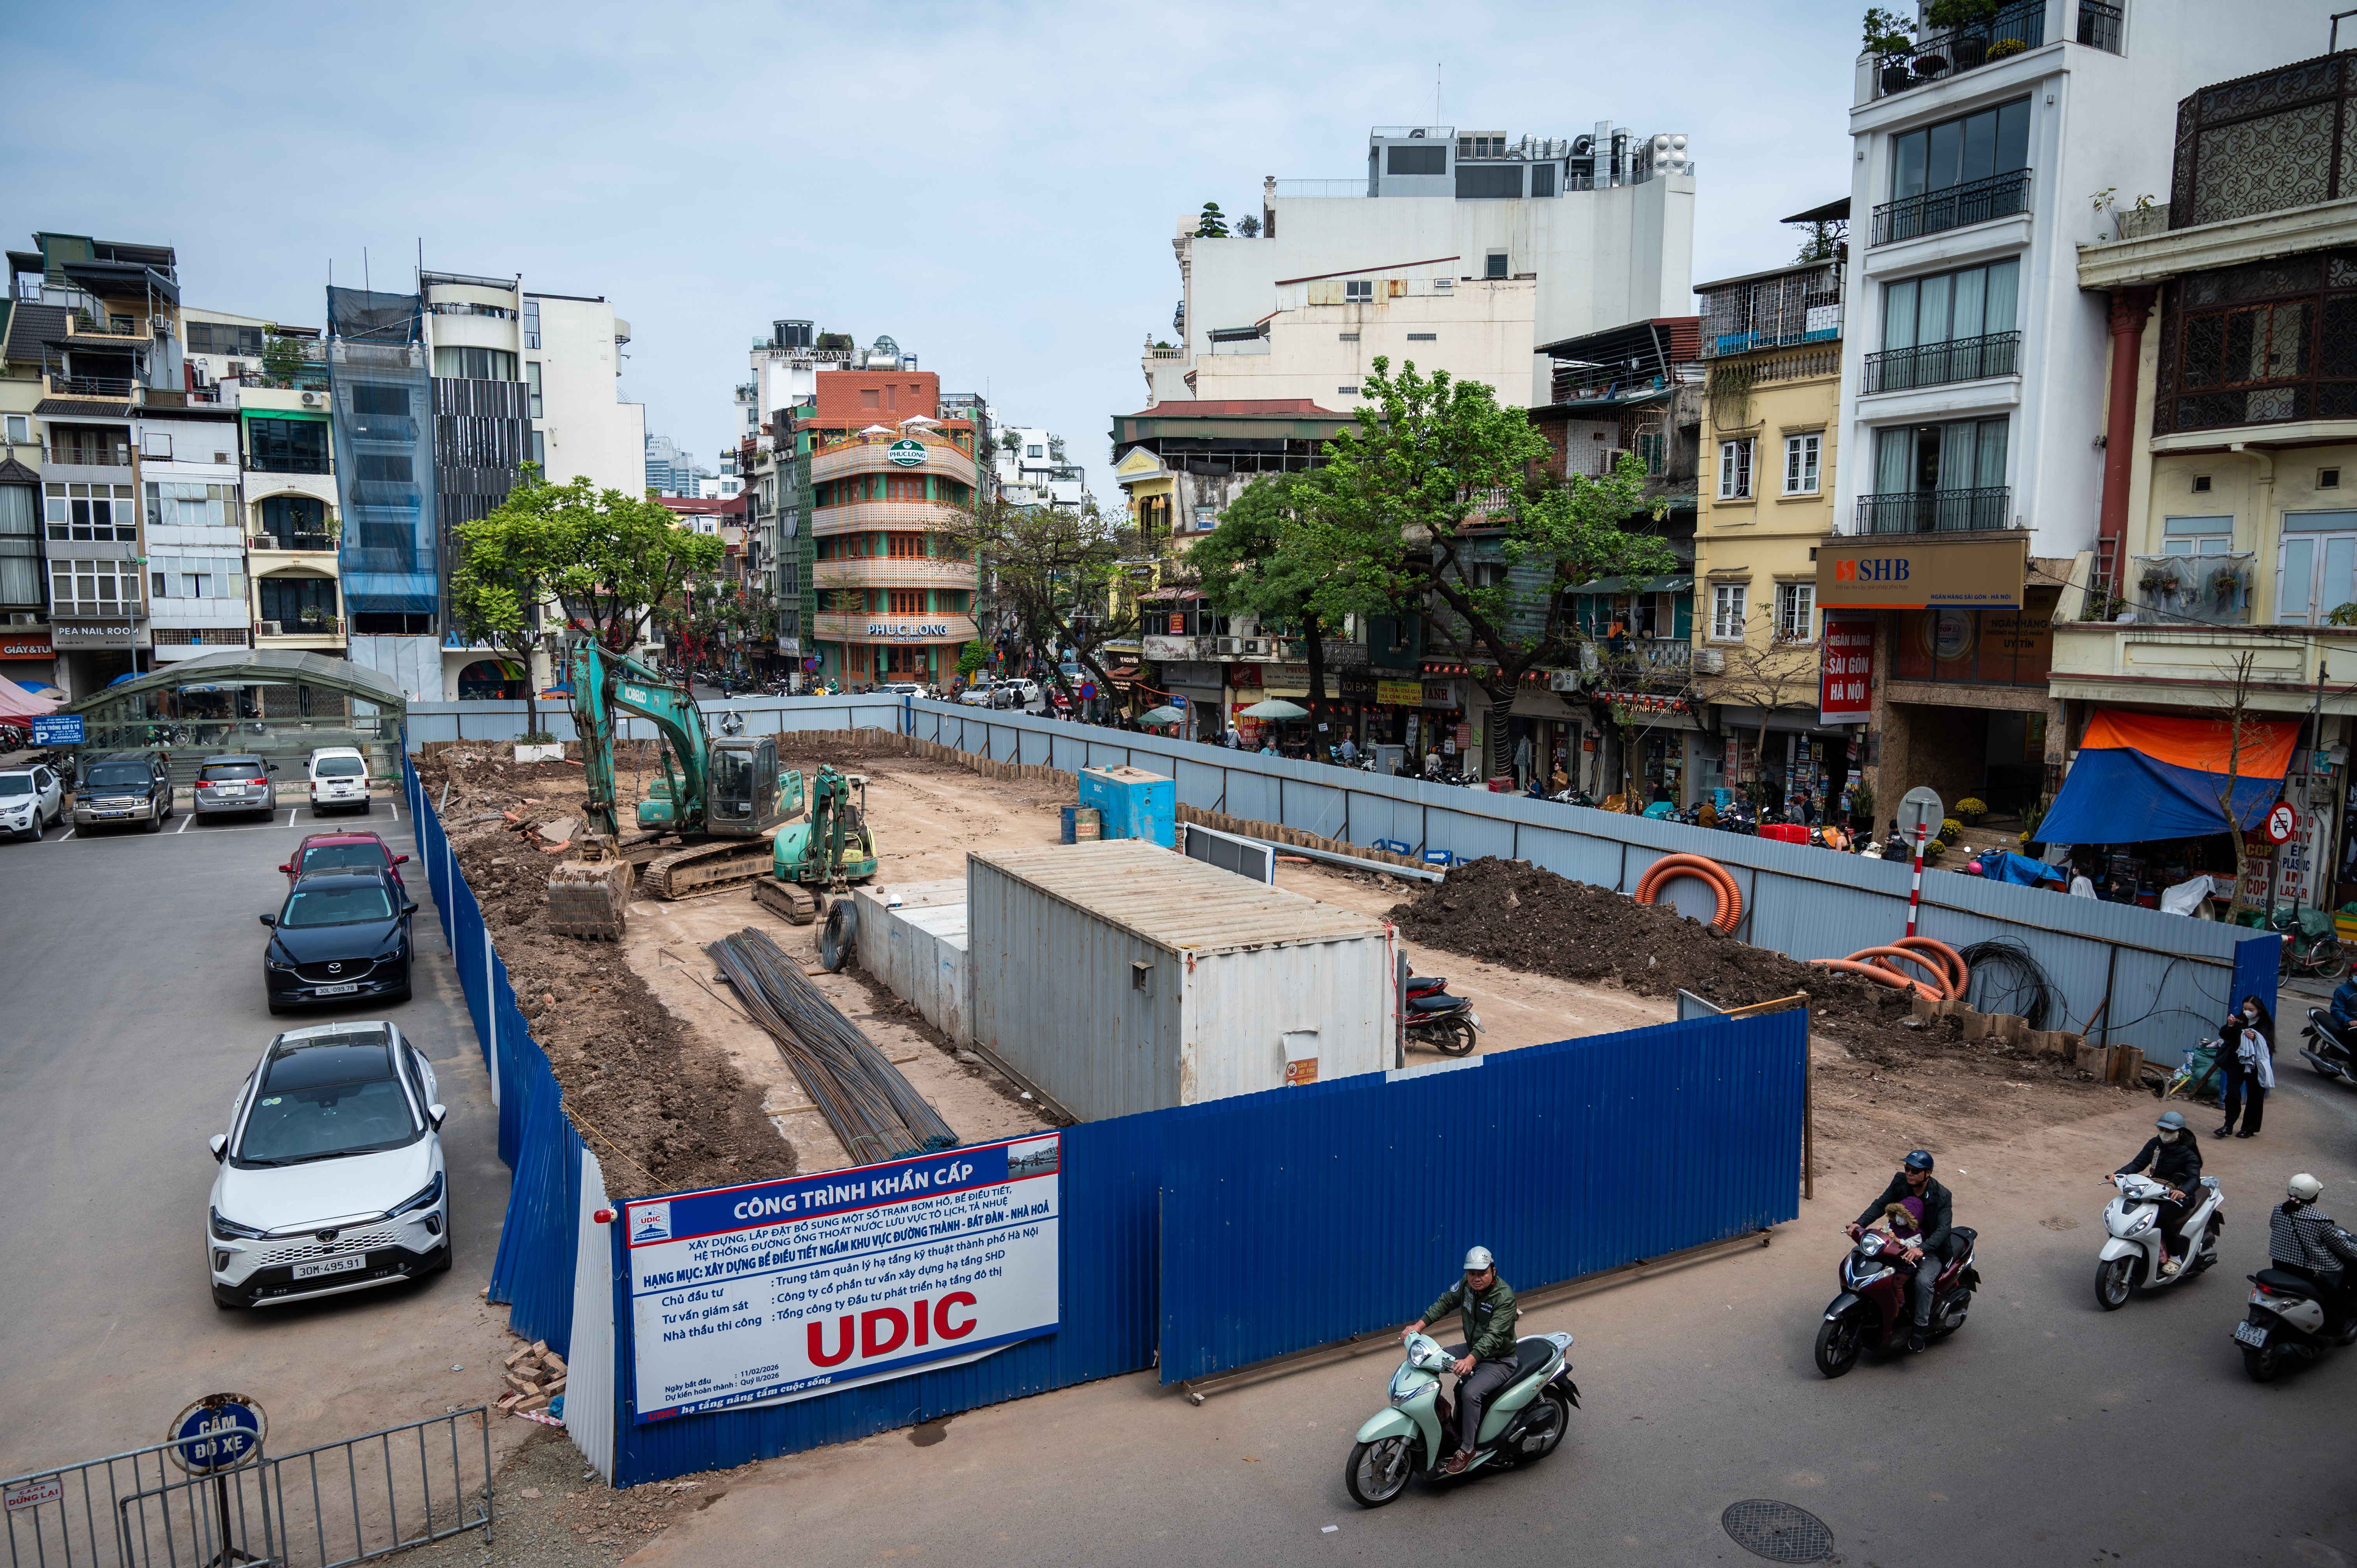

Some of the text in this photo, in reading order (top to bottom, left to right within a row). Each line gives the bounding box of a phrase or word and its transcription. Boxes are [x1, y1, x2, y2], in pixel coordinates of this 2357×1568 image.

[808, 351, 852, 361] GRAND
[1859, 559, 1909, 581] SHB
[2000, 593, 2011, 601] NỘI
[868, 624, 947, 635] PHUC LONG
[1830, 633, 1870, 646] NGÂN HÀNG
[1829, 653, 1869, 674] SÀI GÒN
[625, 686, 647, 704] KOBELCO
[1830, 680, 1864, 703] HÀ NỘI
[1652, 705, 1677, 717] Family
[36, 732, 49, 744] P
[1727, 742, 1737, 753] PHOTO
[1727, 754, 1736, 765] COPY
[2046, 751, 2061, 763] 49
[1726, 766, 1736, 777] SCAN
[1094, 784, 1102, 793] SSC
[1726, 776, 1735, 788] in
[2282, 857, 2310, 872] PLASIC
[319, 985, 354, 994] 30L-099.78
[734, 1160, 973, 1219] CÔNG TRÌNH KHẨN CẤP
[688, 1185, 1012, 1251] XÂY DỰNG, LẮP ĐẶT BỔ SUNG MỘT SỐ TRẠM BƠM HỒ, BỂ ĐIỀU TIẾT,
[643, 1199, 1050, 1290] HẠNG MỤC: XÂY DỰNG BỂ ĐIỀU TIẾT NGẦM KHU VỰC ĐƯỜNG THÀNH BÁT ĐÀN NHÀ HOẢ
[299, 1259, 359, 1276] 30M-495.91
[807, 1291, 976, 1367] UDIC
[2241, 1323, 2262, 1337] 29-P1
[2236, 1330, 2262, 1345] 533.57
[664, 1363, 779, 1393] Ngày bắt đầu 11/02/2026
[647, 1376, 831, 1421] UDIC hạ tầng nâng tầm cuộc sống
[222, 1435, 243, 1453] XE
[19, 1485, 45, 1495] C.A.H.N
[9, 1489, 58, 1506] DỪNG LẠI
